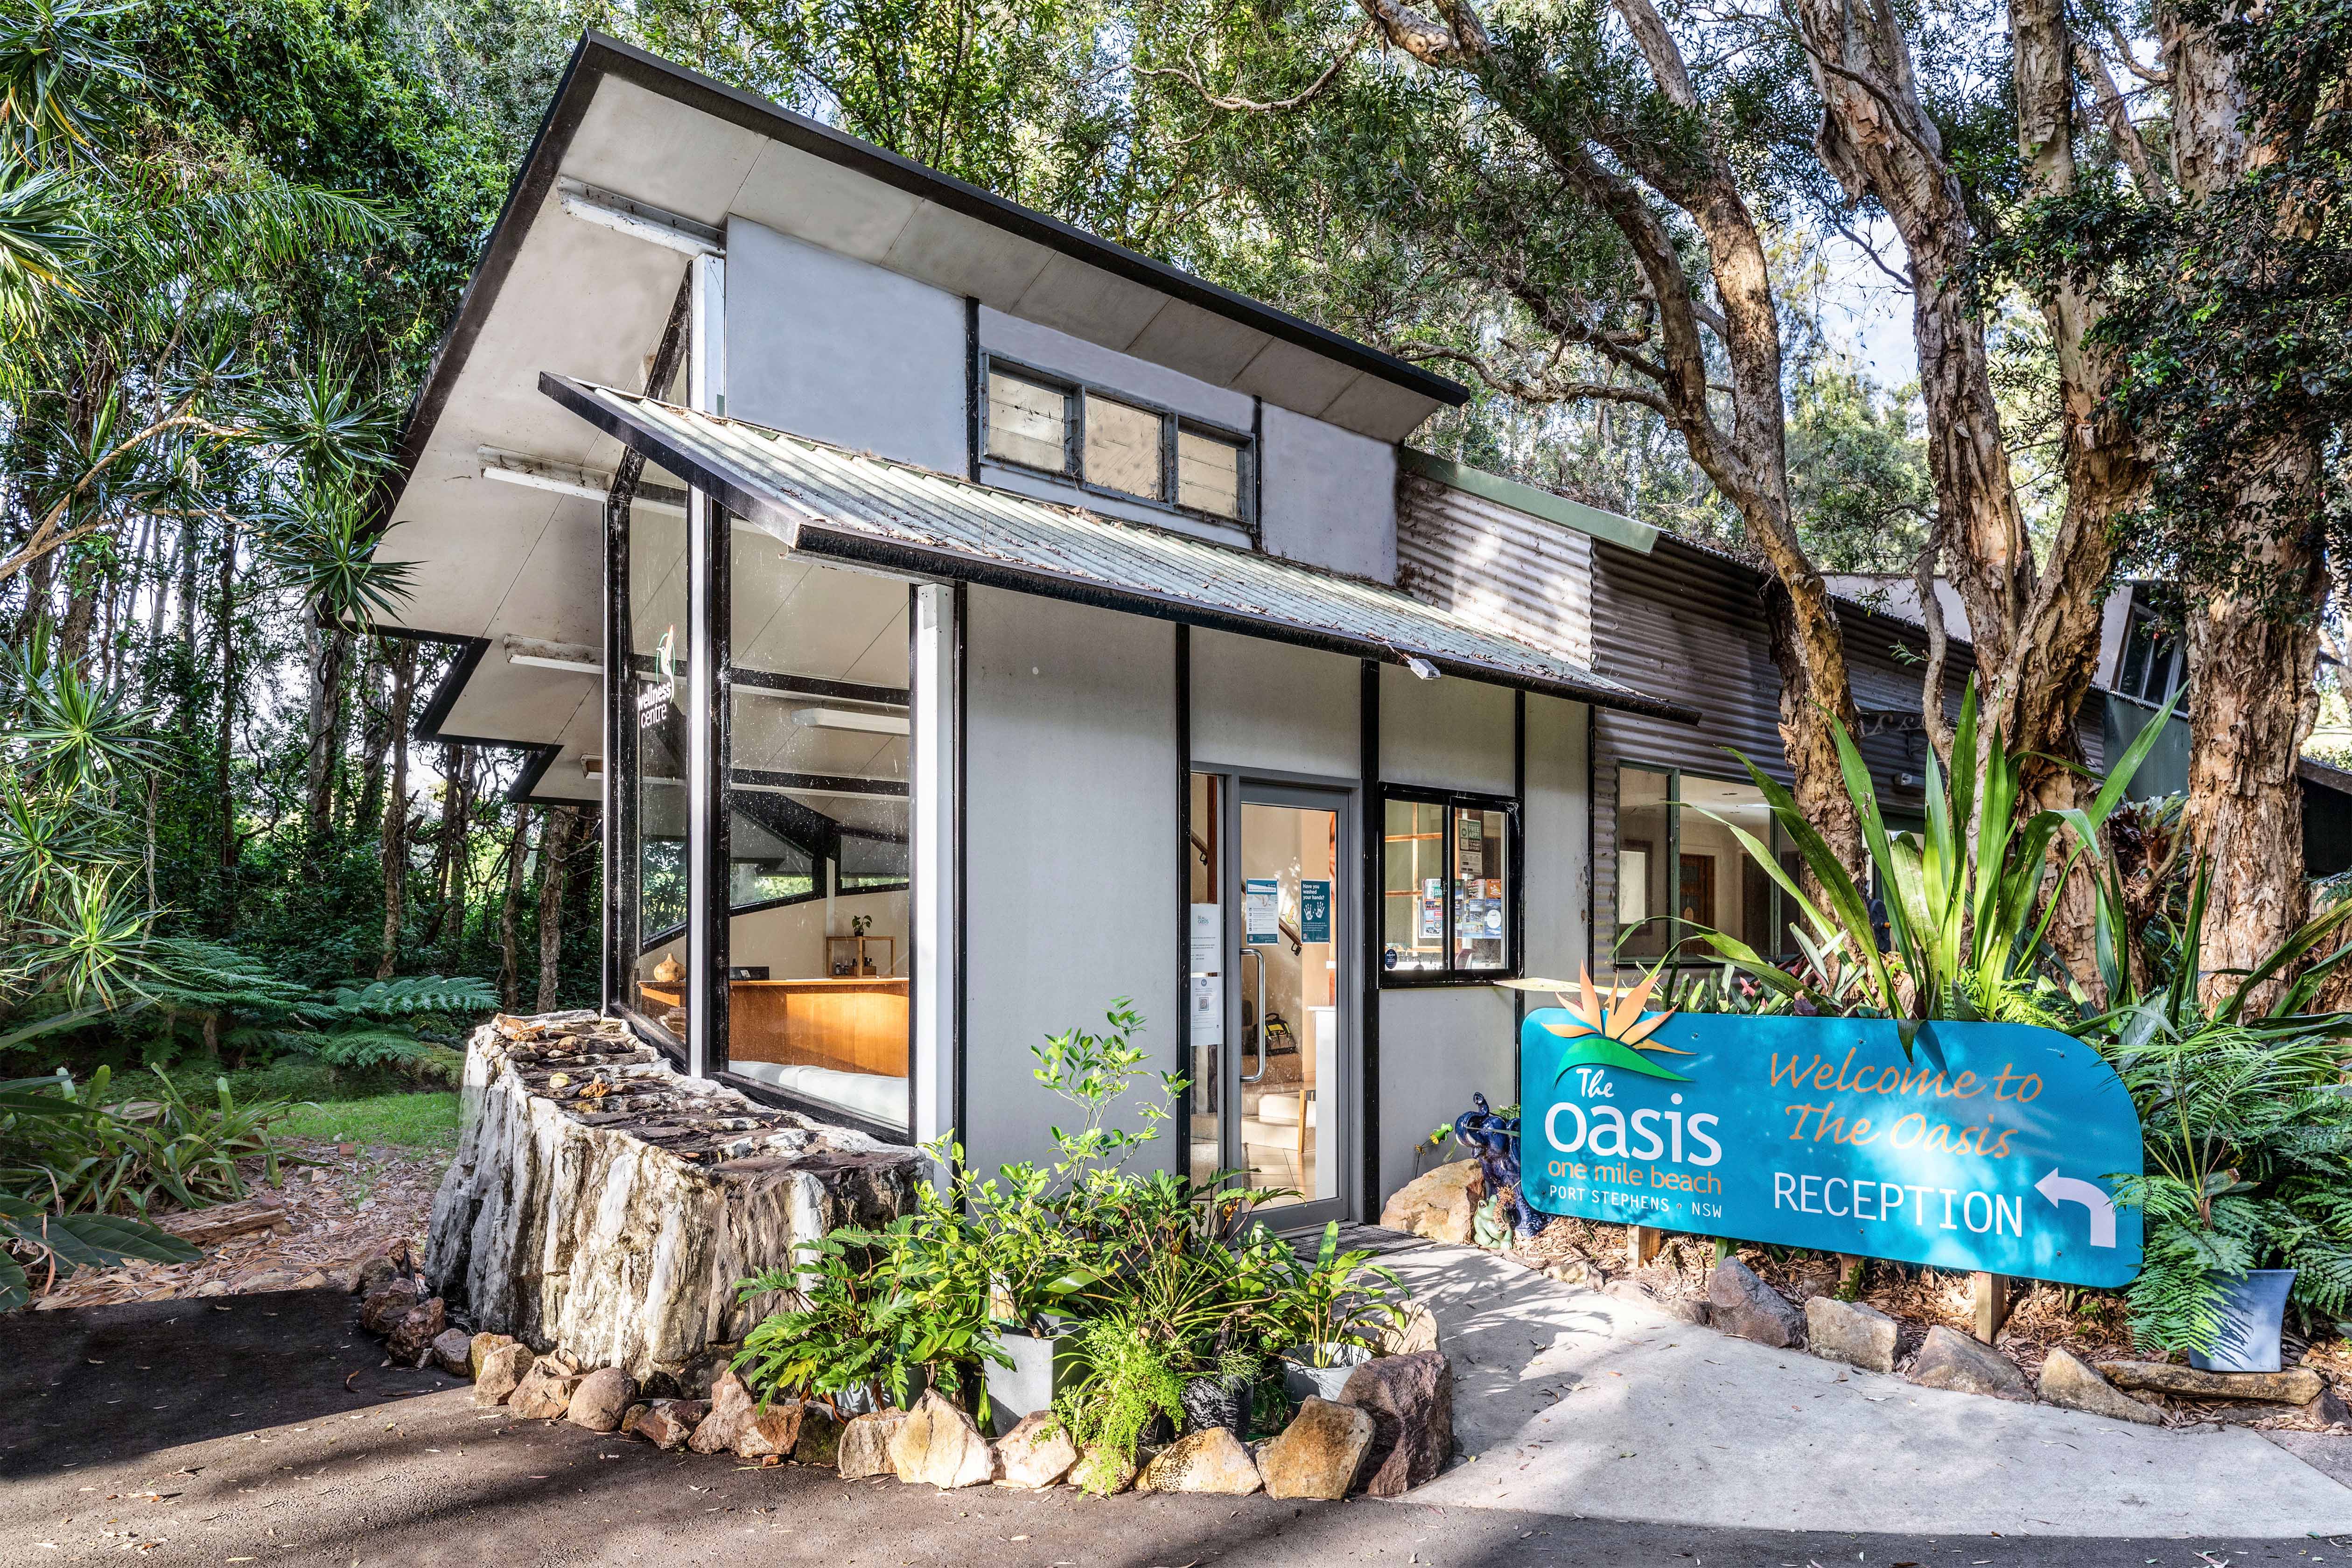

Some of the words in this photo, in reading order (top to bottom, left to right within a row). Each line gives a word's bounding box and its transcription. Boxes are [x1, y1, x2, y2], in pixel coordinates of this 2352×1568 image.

[637, 682, 671, 711] wellness
[641, 704, 666, 728] centre
[1576, 1068, 1614, 1098] The
[1770, 1047, 1987, 1099] Welcome
[1993, 1063, 2043, 1102] to
[1545, 1093, 1722, 1166] oasis
[1785, 1101, 1882, 1146] The
[1890, 1113, 2018, 1158] Oasis
[1548, 1160, 1588, 1180] one
[1595, 1162, 1643, 1186] mile
[1651, 1165, 1722, 1195] beach
[1550, 1185, 1585, 1201] PORT
[1591, 1190, 1669, 1212] STEPHENS
[1692, 1202, 1722, 1218] NSW
[1774, 1172, 2022, 1238] RECEPTION
